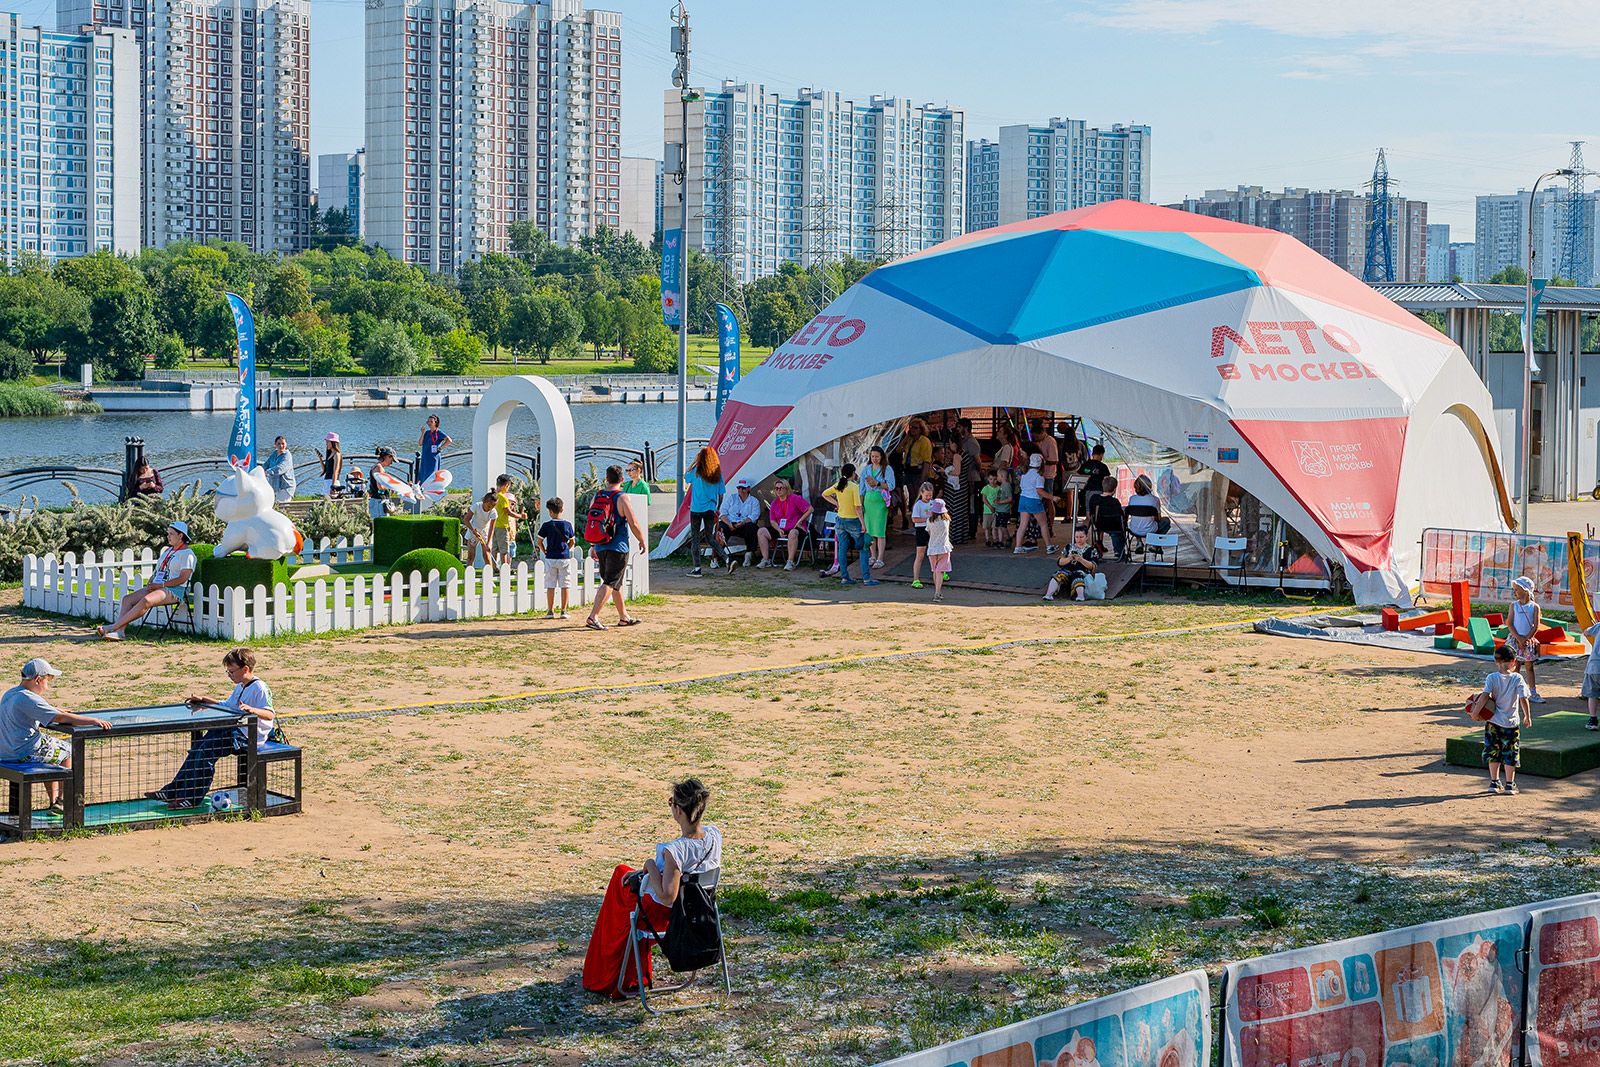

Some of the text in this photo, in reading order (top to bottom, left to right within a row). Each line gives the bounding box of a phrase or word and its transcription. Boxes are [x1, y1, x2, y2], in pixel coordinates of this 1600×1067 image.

[1210, 320, 1361, 358] ЛЕТО
[768, 352, 834, 370] МОСКВЕ
[1216, 363, 1242, 380] В
[1329, 443, 1361, 452] ПРОЕКТ
[1332, 453, 1358, 462] МЭРА
[1335, 460, 1374, 471] МОСКВЫ
[1557, 1041, 1569, 1057] В
